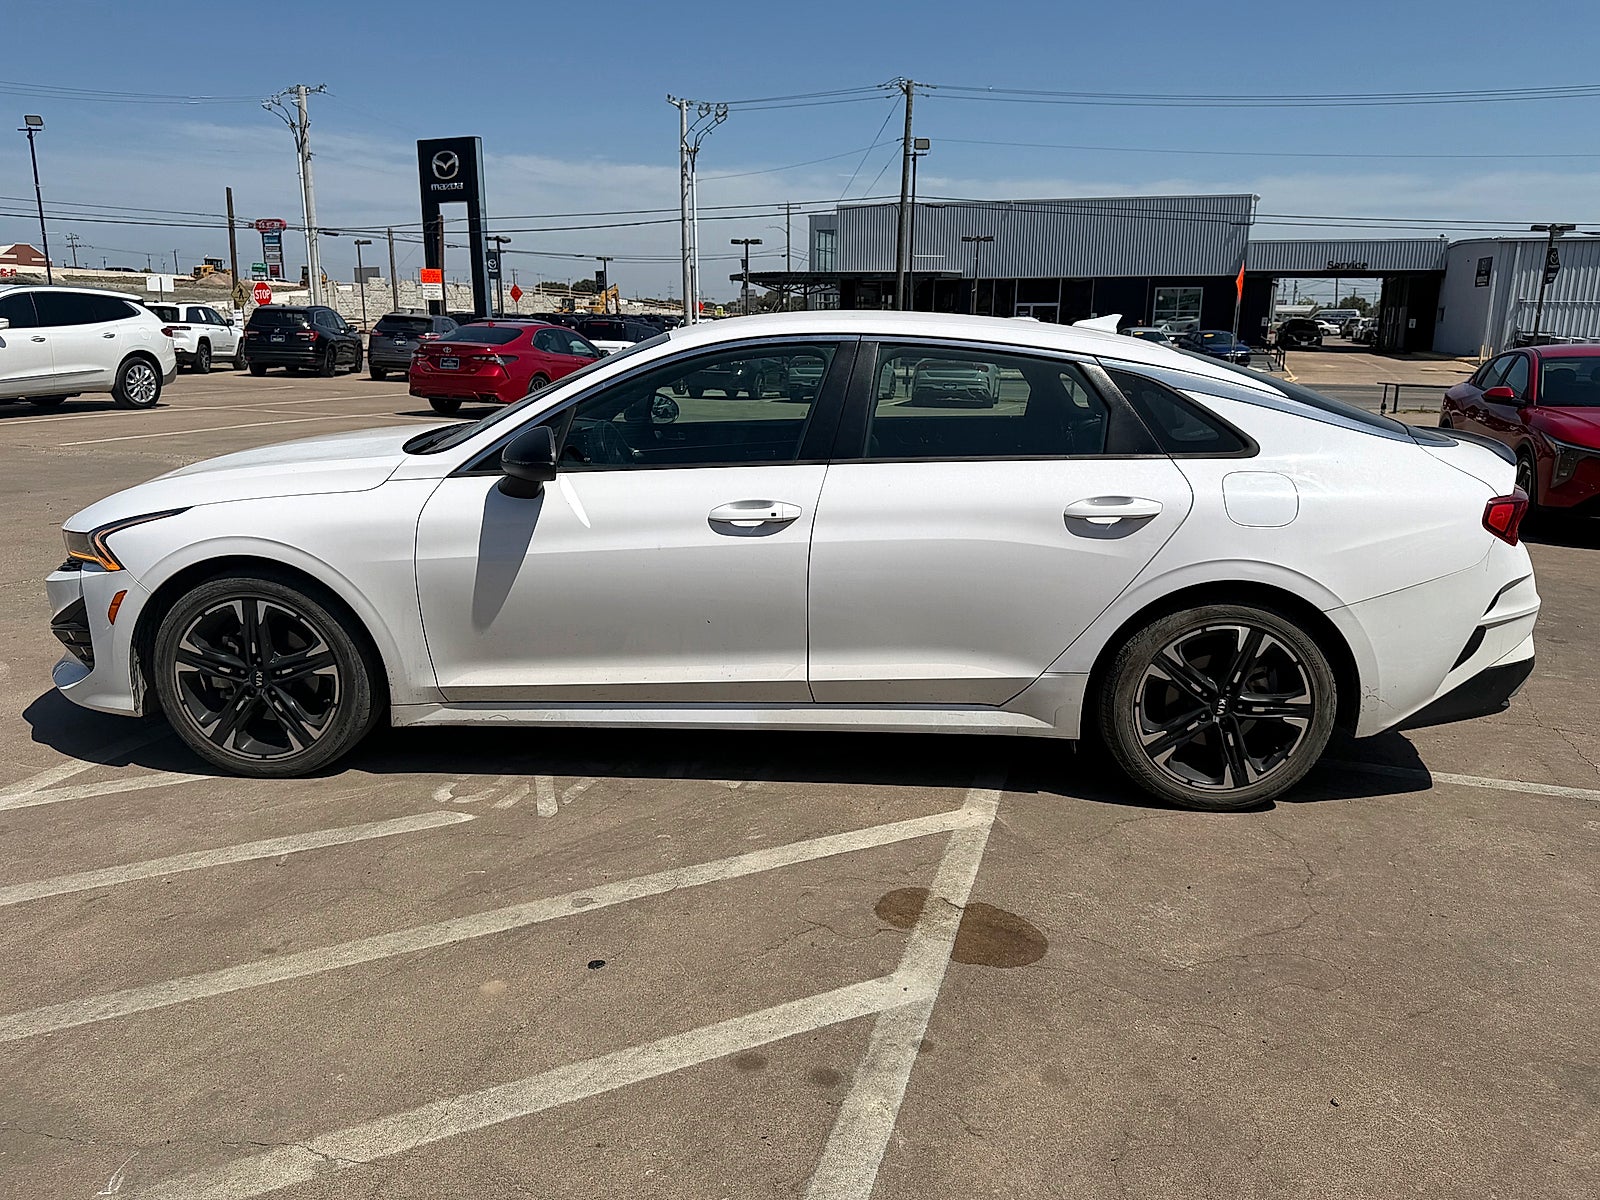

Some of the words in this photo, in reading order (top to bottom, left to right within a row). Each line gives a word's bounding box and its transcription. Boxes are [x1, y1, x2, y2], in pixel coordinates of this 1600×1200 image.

[431, 183, 463, 191] mazda
[1327, 260, 1368, 270] Service
[254, 289, 271, 300] STOP
[1216, 699, 1226, 714] KIA
